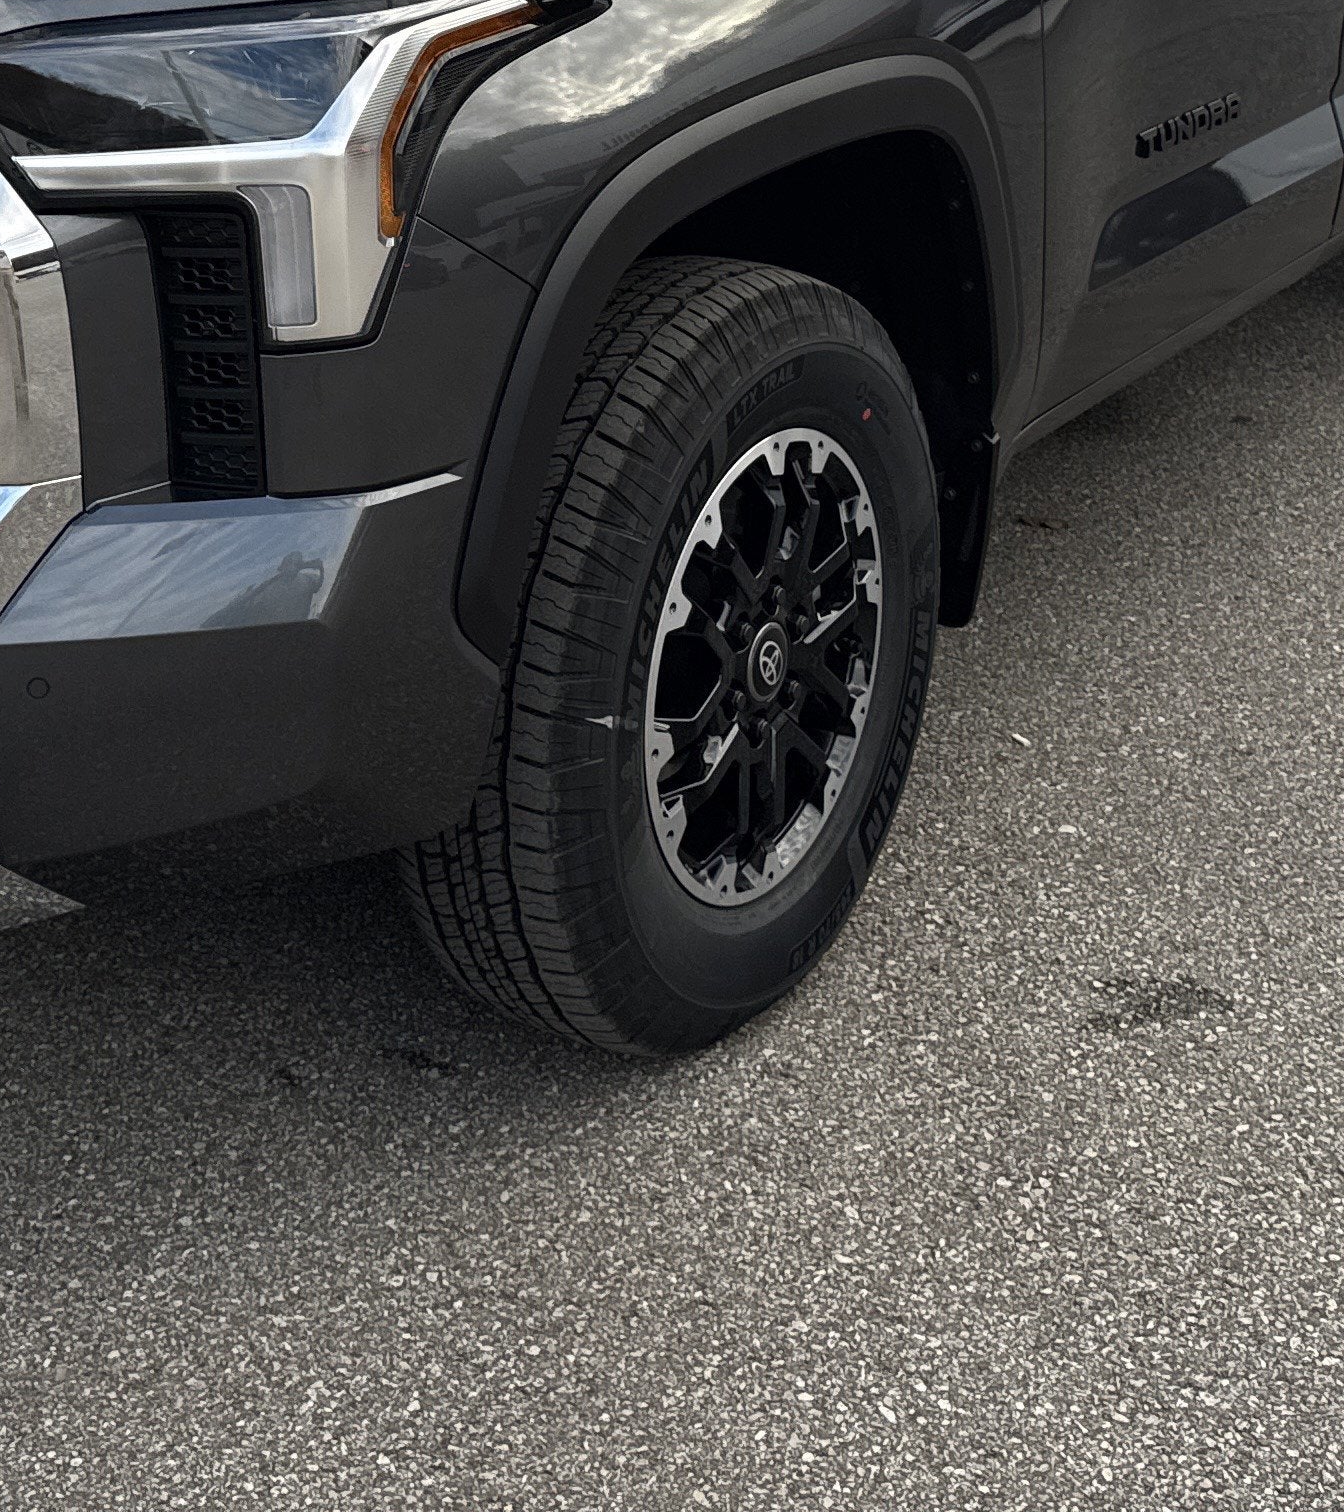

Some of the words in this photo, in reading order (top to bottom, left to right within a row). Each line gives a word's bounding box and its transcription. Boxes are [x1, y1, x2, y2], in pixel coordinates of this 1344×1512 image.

[1135, 91, 1241, 158] TUNDRA
[732, 386, 760, 425] LTX
[760, 361, 796, 396] TRAIL
[861, 610, 931, 848] MICHELIN
